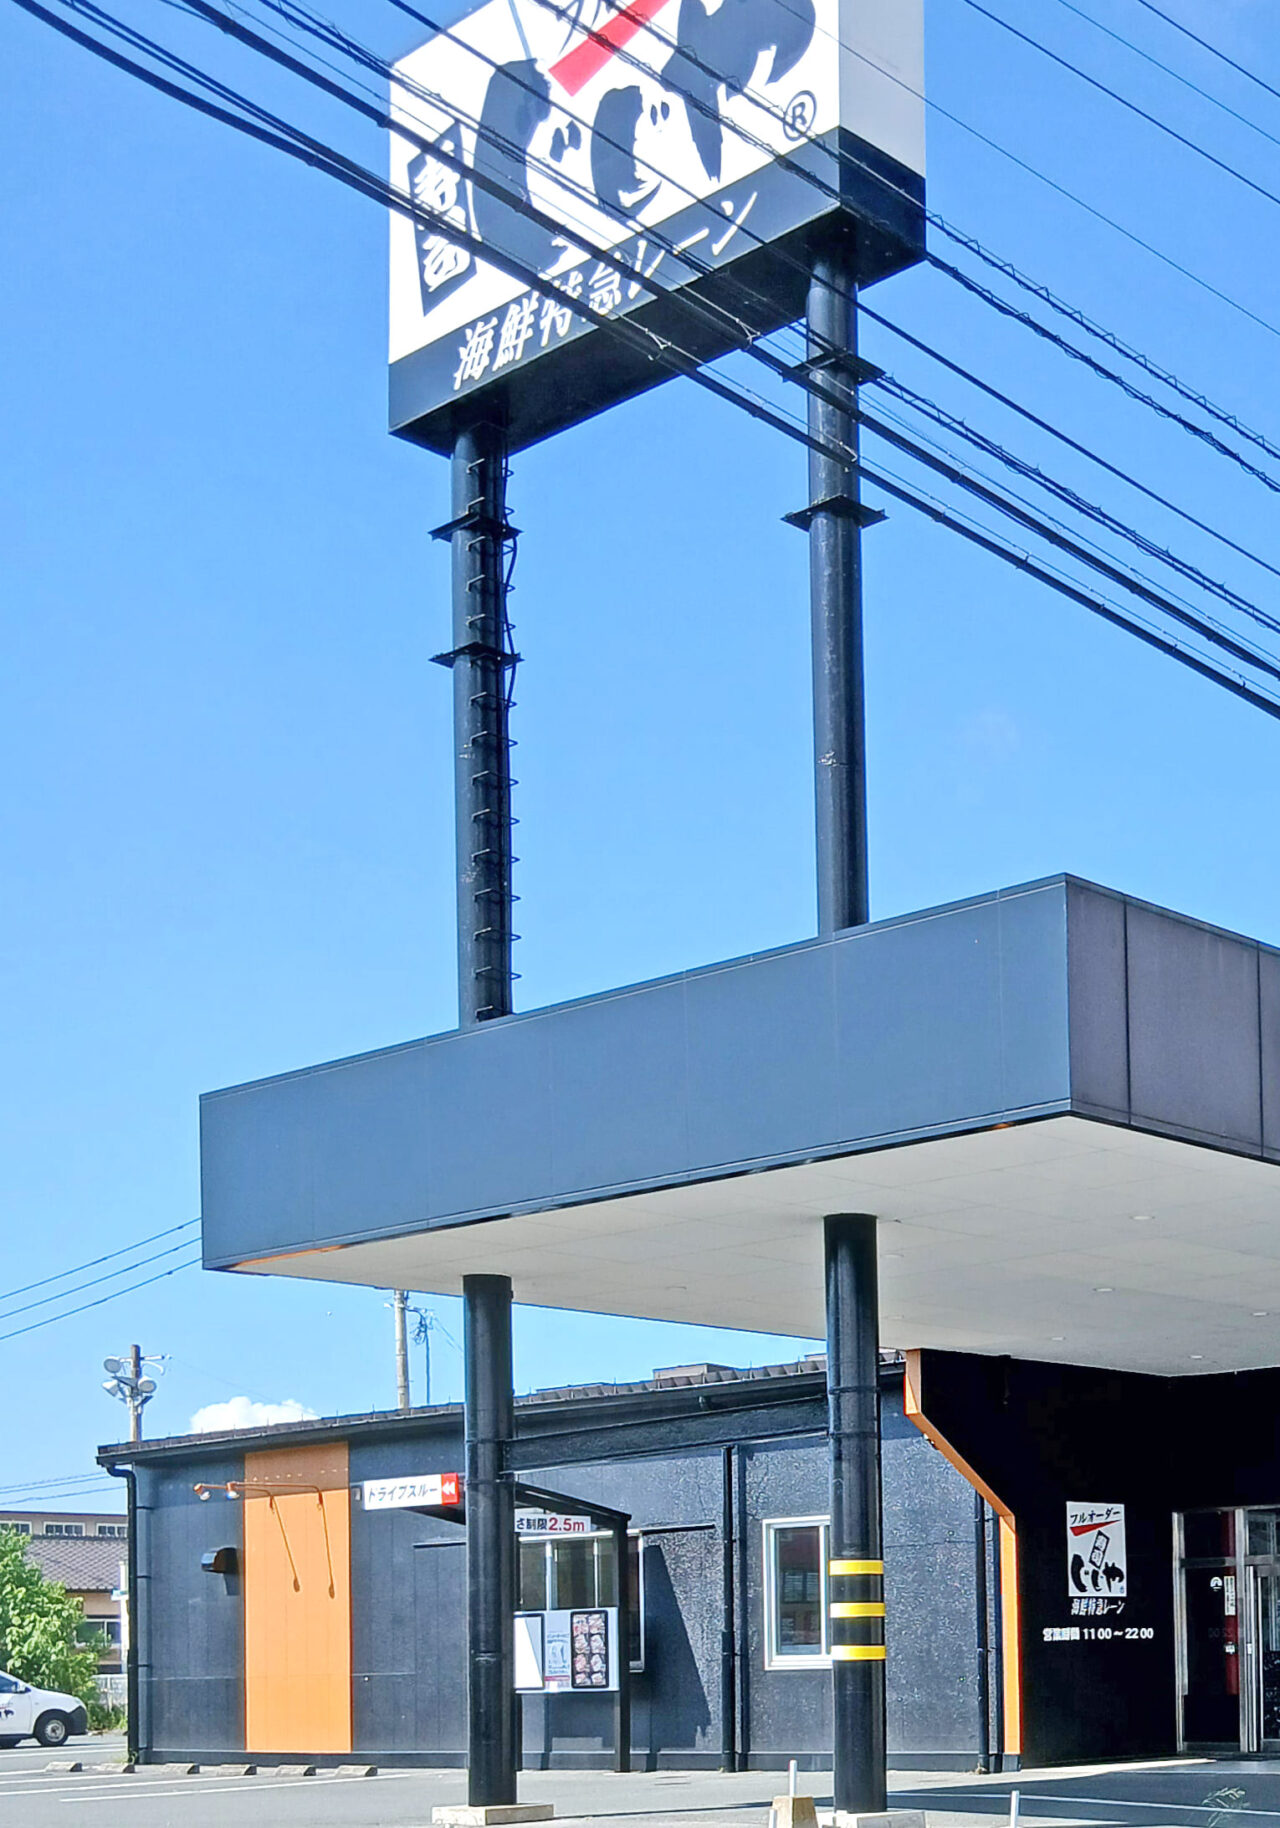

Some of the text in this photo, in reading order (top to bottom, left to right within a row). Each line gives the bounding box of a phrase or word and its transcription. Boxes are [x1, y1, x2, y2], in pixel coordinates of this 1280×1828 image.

[1070, 1507, 1121, 1525] フルオーダー
